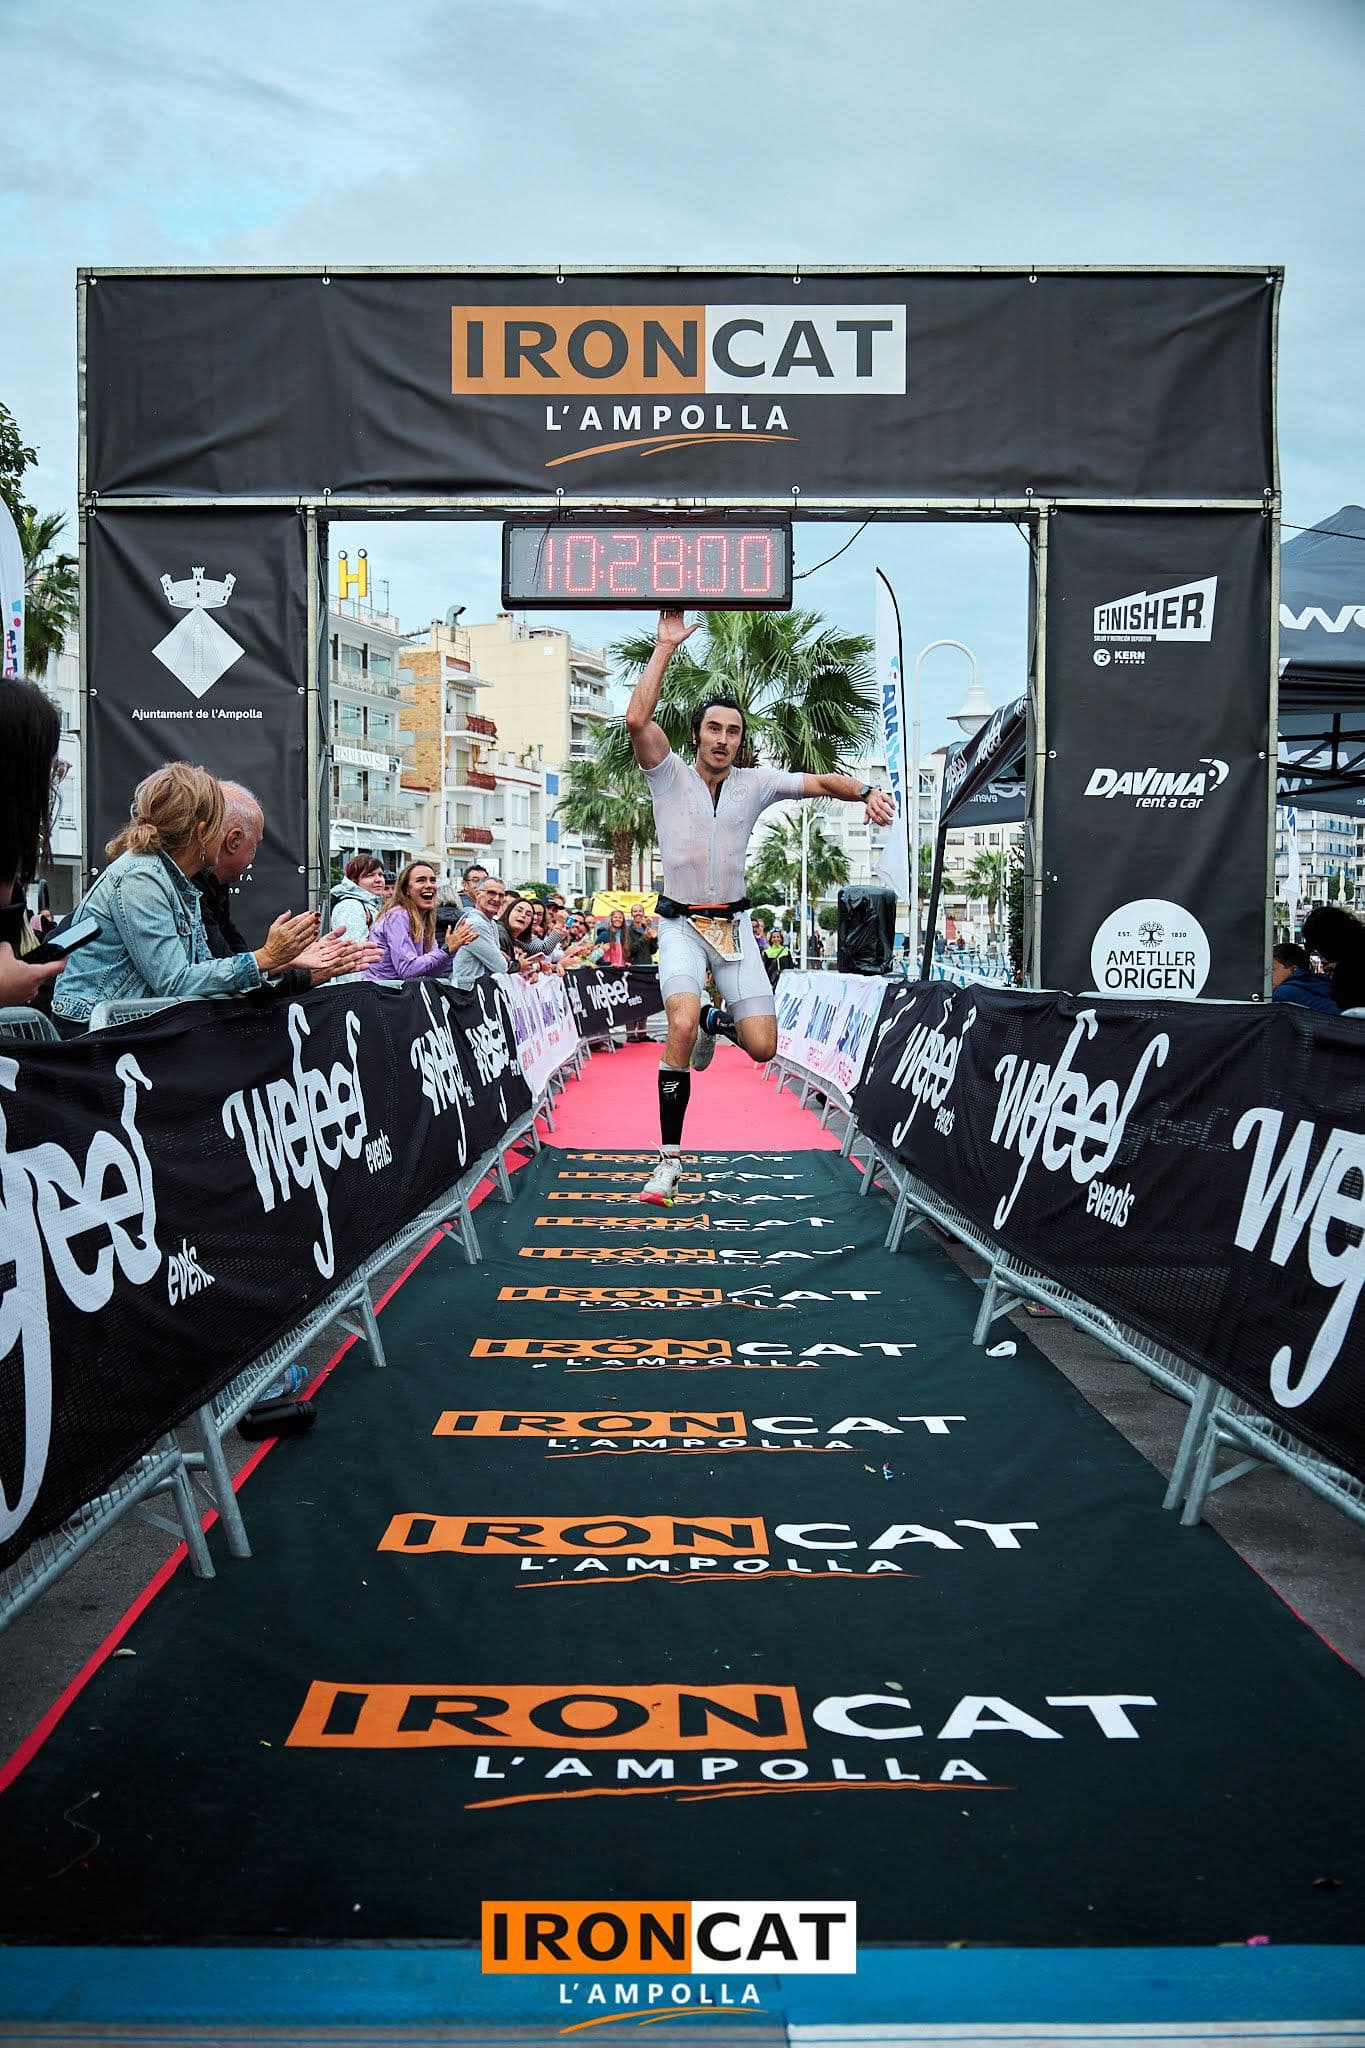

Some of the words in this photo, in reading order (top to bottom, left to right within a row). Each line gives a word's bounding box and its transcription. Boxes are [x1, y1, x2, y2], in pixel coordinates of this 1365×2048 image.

[466, 319, 893, 379] IRONCAT
[546, 405, 790, 431] L'AMPOLLA
[546, 535, 772, 592] 10:28:00
[338, 557, 367, 599] H
[1098, 592, 1204, 631] FINISHER
[1114, 651, 1146, 660] KERN
[132, 708, 193, 720] Ajuntament
[195, 708, 209, 719] de
[211, 708, 263, 721] l'Ampolla
[1084, 767, 1206, 798] DAVIMA
[1135, 796, 1167, 808] rent
[1168, 798, 1177, 808] a
[1180, 798, 1204, 809] car
[1106, 950, 1196, 966] AMETLLER
[1105, 967, 1195, 989] ORIGEN
[364, 1129, 392, 1174] events
[1086, 1179, 1136, 1228] events
[512, 1285, 882, 1302] IRONCAT
[486, 1341, 918, 1357] IRONCAT
[566, 1357, 821, 1368] L'AMPOLLA
[452, 1413, 967, 1435] IRONCAT
[548, 1437, 855, 1450] L'AMPOLLA
[403, 1518, 1039, 1551] IRONCAT
[519, 1556, 904, 1574] L'AMPOLLA
[322, 1691, 1158, 1741] IRONCAT
[473, 1756, 990, 1782] L'AMPOLLA
